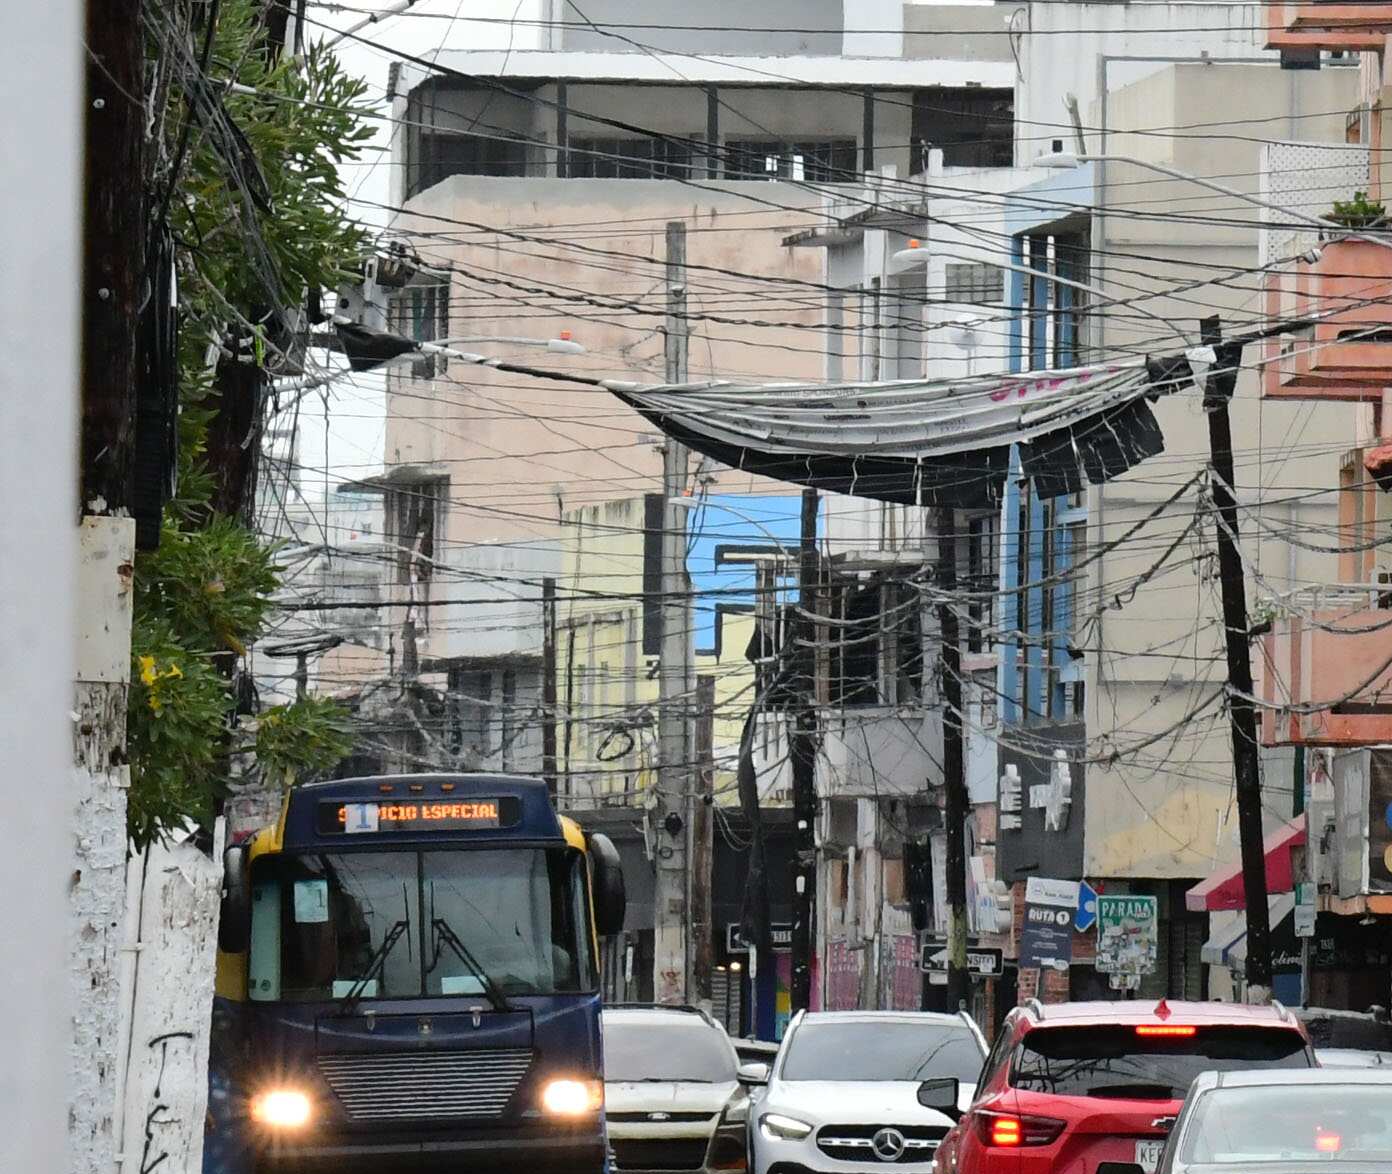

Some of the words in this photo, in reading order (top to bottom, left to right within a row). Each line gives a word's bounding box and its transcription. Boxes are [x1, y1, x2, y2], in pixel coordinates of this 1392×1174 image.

[355, 803, 372, 830] 1
[422, 803, 498, 820] ESPECIAL
[1028, 908, 1055, 923] RUTA
[1102, 900, 1151, 918] PARADA
